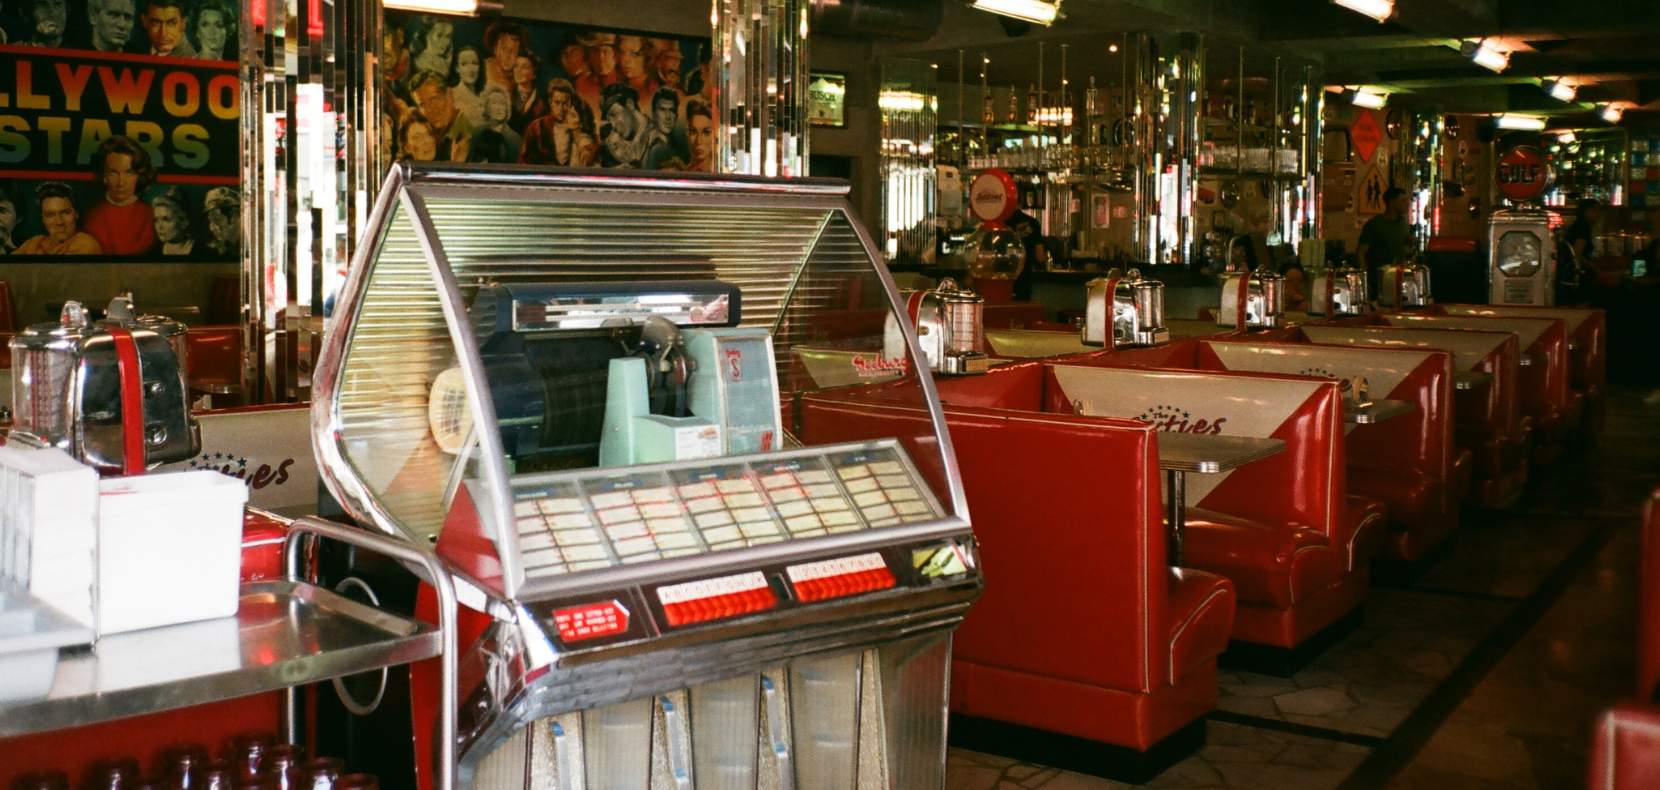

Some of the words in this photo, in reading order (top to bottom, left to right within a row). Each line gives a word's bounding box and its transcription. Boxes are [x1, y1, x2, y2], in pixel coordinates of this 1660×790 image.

[0, 60, 239, 120] LYWOO
[0, 115, 211, 170] STARS
[1500, 161, 1540, 184] GULF
[1150, 414, 1227, 435] ties
